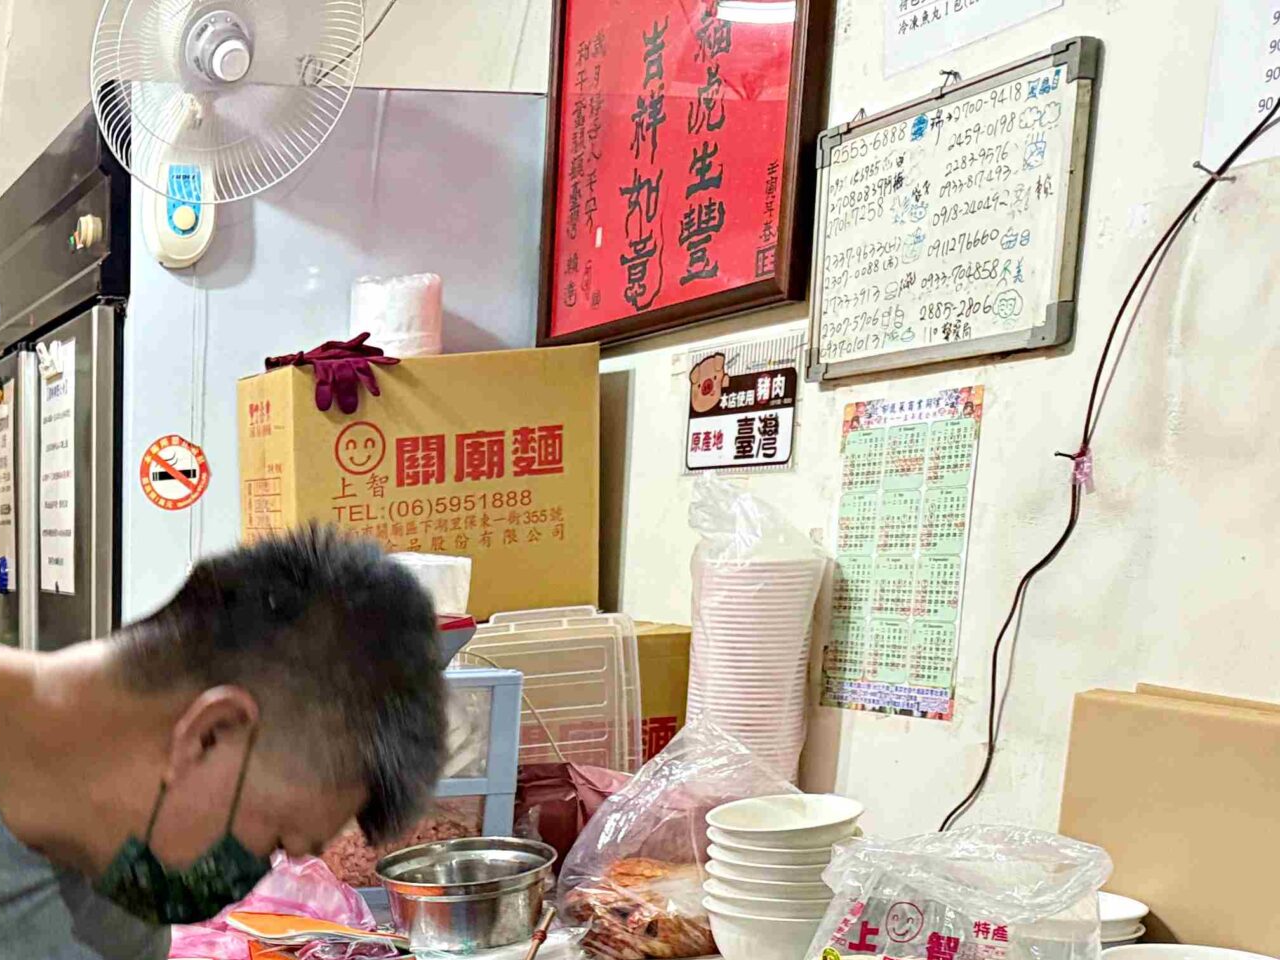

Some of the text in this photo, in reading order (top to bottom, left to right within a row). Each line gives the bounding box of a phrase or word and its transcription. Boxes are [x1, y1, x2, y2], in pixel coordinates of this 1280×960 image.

[1257, 96, 1273, 113] 90
[833, 122, 908, 165] 2553-6888
[927, 228, 999, 258] 0911276660
[691, 411, 781, 461] 原產地 臺灣
[395, 424, 565, 489] 關廟麵
[331, 473, 390, 500] 上智
[973, 920, 1009, 942] 特產
